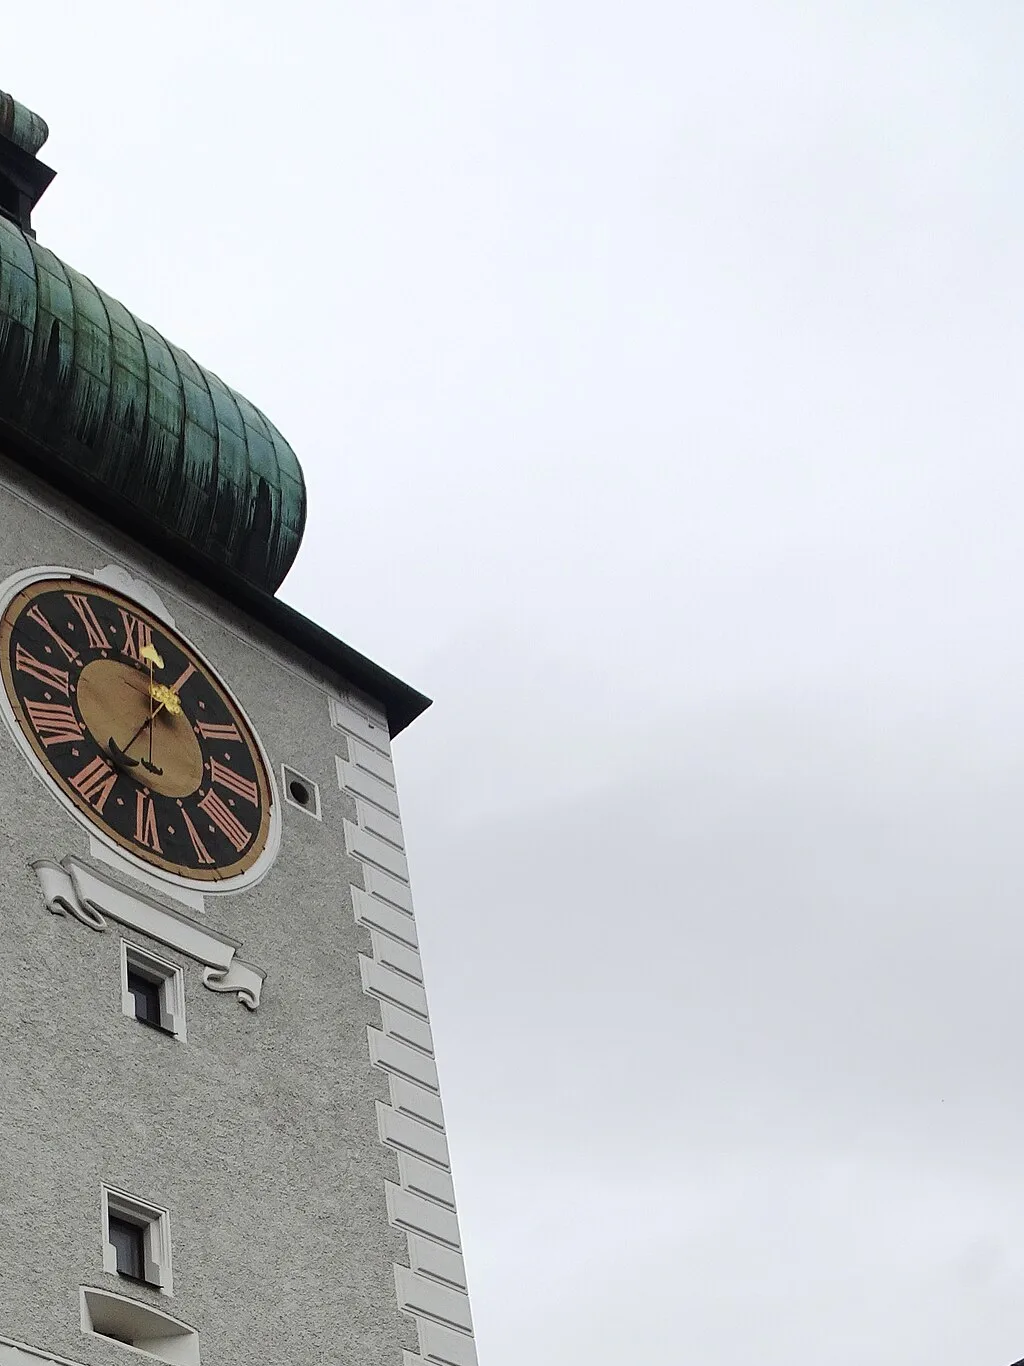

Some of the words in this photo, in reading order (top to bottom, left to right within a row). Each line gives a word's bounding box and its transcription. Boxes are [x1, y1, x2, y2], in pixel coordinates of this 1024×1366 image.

[27, 605, 80, 661] X
[65, 595, 112, 649] XI
[16, 643, 71, 697] IX
[197, 721, 243, 743] II
[209, 756, 259, 808] III
[134, 789, 164, 854] VI
[181, 807, 215, 864] V
[198, 788, 252, 853] IIII
